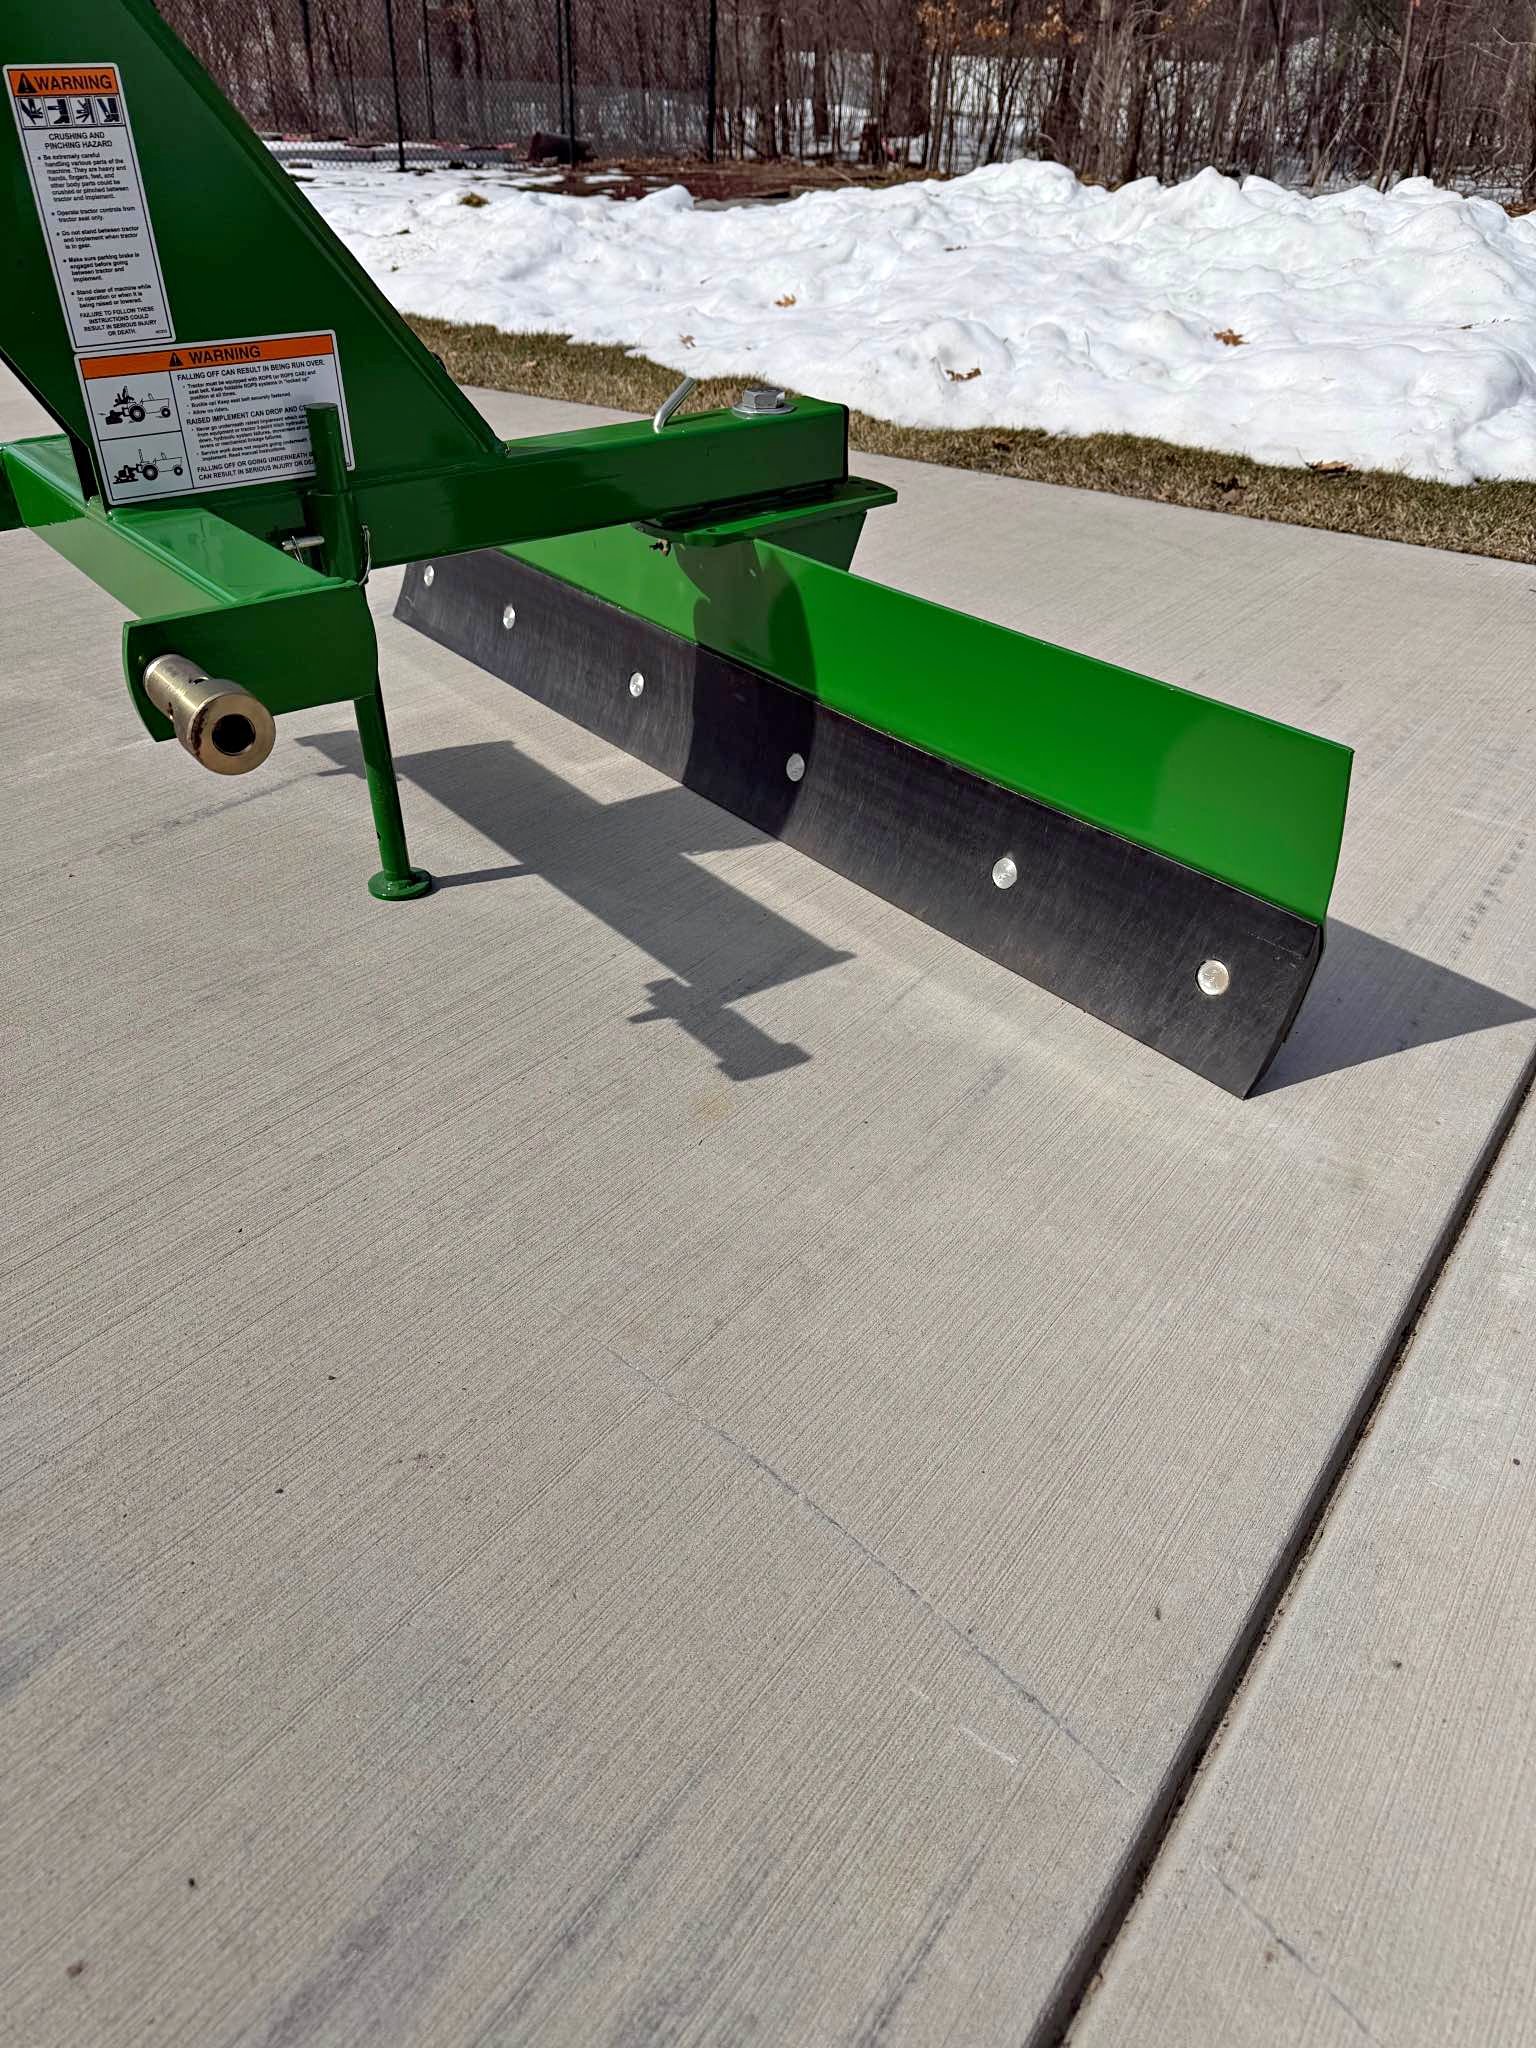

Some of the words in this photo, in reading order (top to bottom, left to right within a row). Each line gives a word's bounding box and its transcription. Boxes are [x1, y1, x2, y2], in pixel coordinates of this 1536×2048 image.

[34, 75, 112, 89] WARNING
[48, 132, 87, 140] CRUSHING
[45, 141, 80, 149] PINCHING
[82, 140, 112, 148] HAZARD
[89, 316, 129, 324] INSTRUCTIONS
[188, 346, 260, 364] WARNING
[177, 372, 205, 380] FALLING
[221, 368, 235, 376] CAN
[237, 365, 261, 374] RESULT
[270, 363, 290, 371] BEING
[306, 359, 325, 367] OVER.
[212, 412, 249, 421] IMPLEMENT
[266, 408, 283, 416] DROP
[197, 464, 223, 472] FALLING
[269, 453, 307, 462] UNDERNEATH
[213, 470, 236, 478] RESULT
[246, 465, 271, 474] SERIOUS
